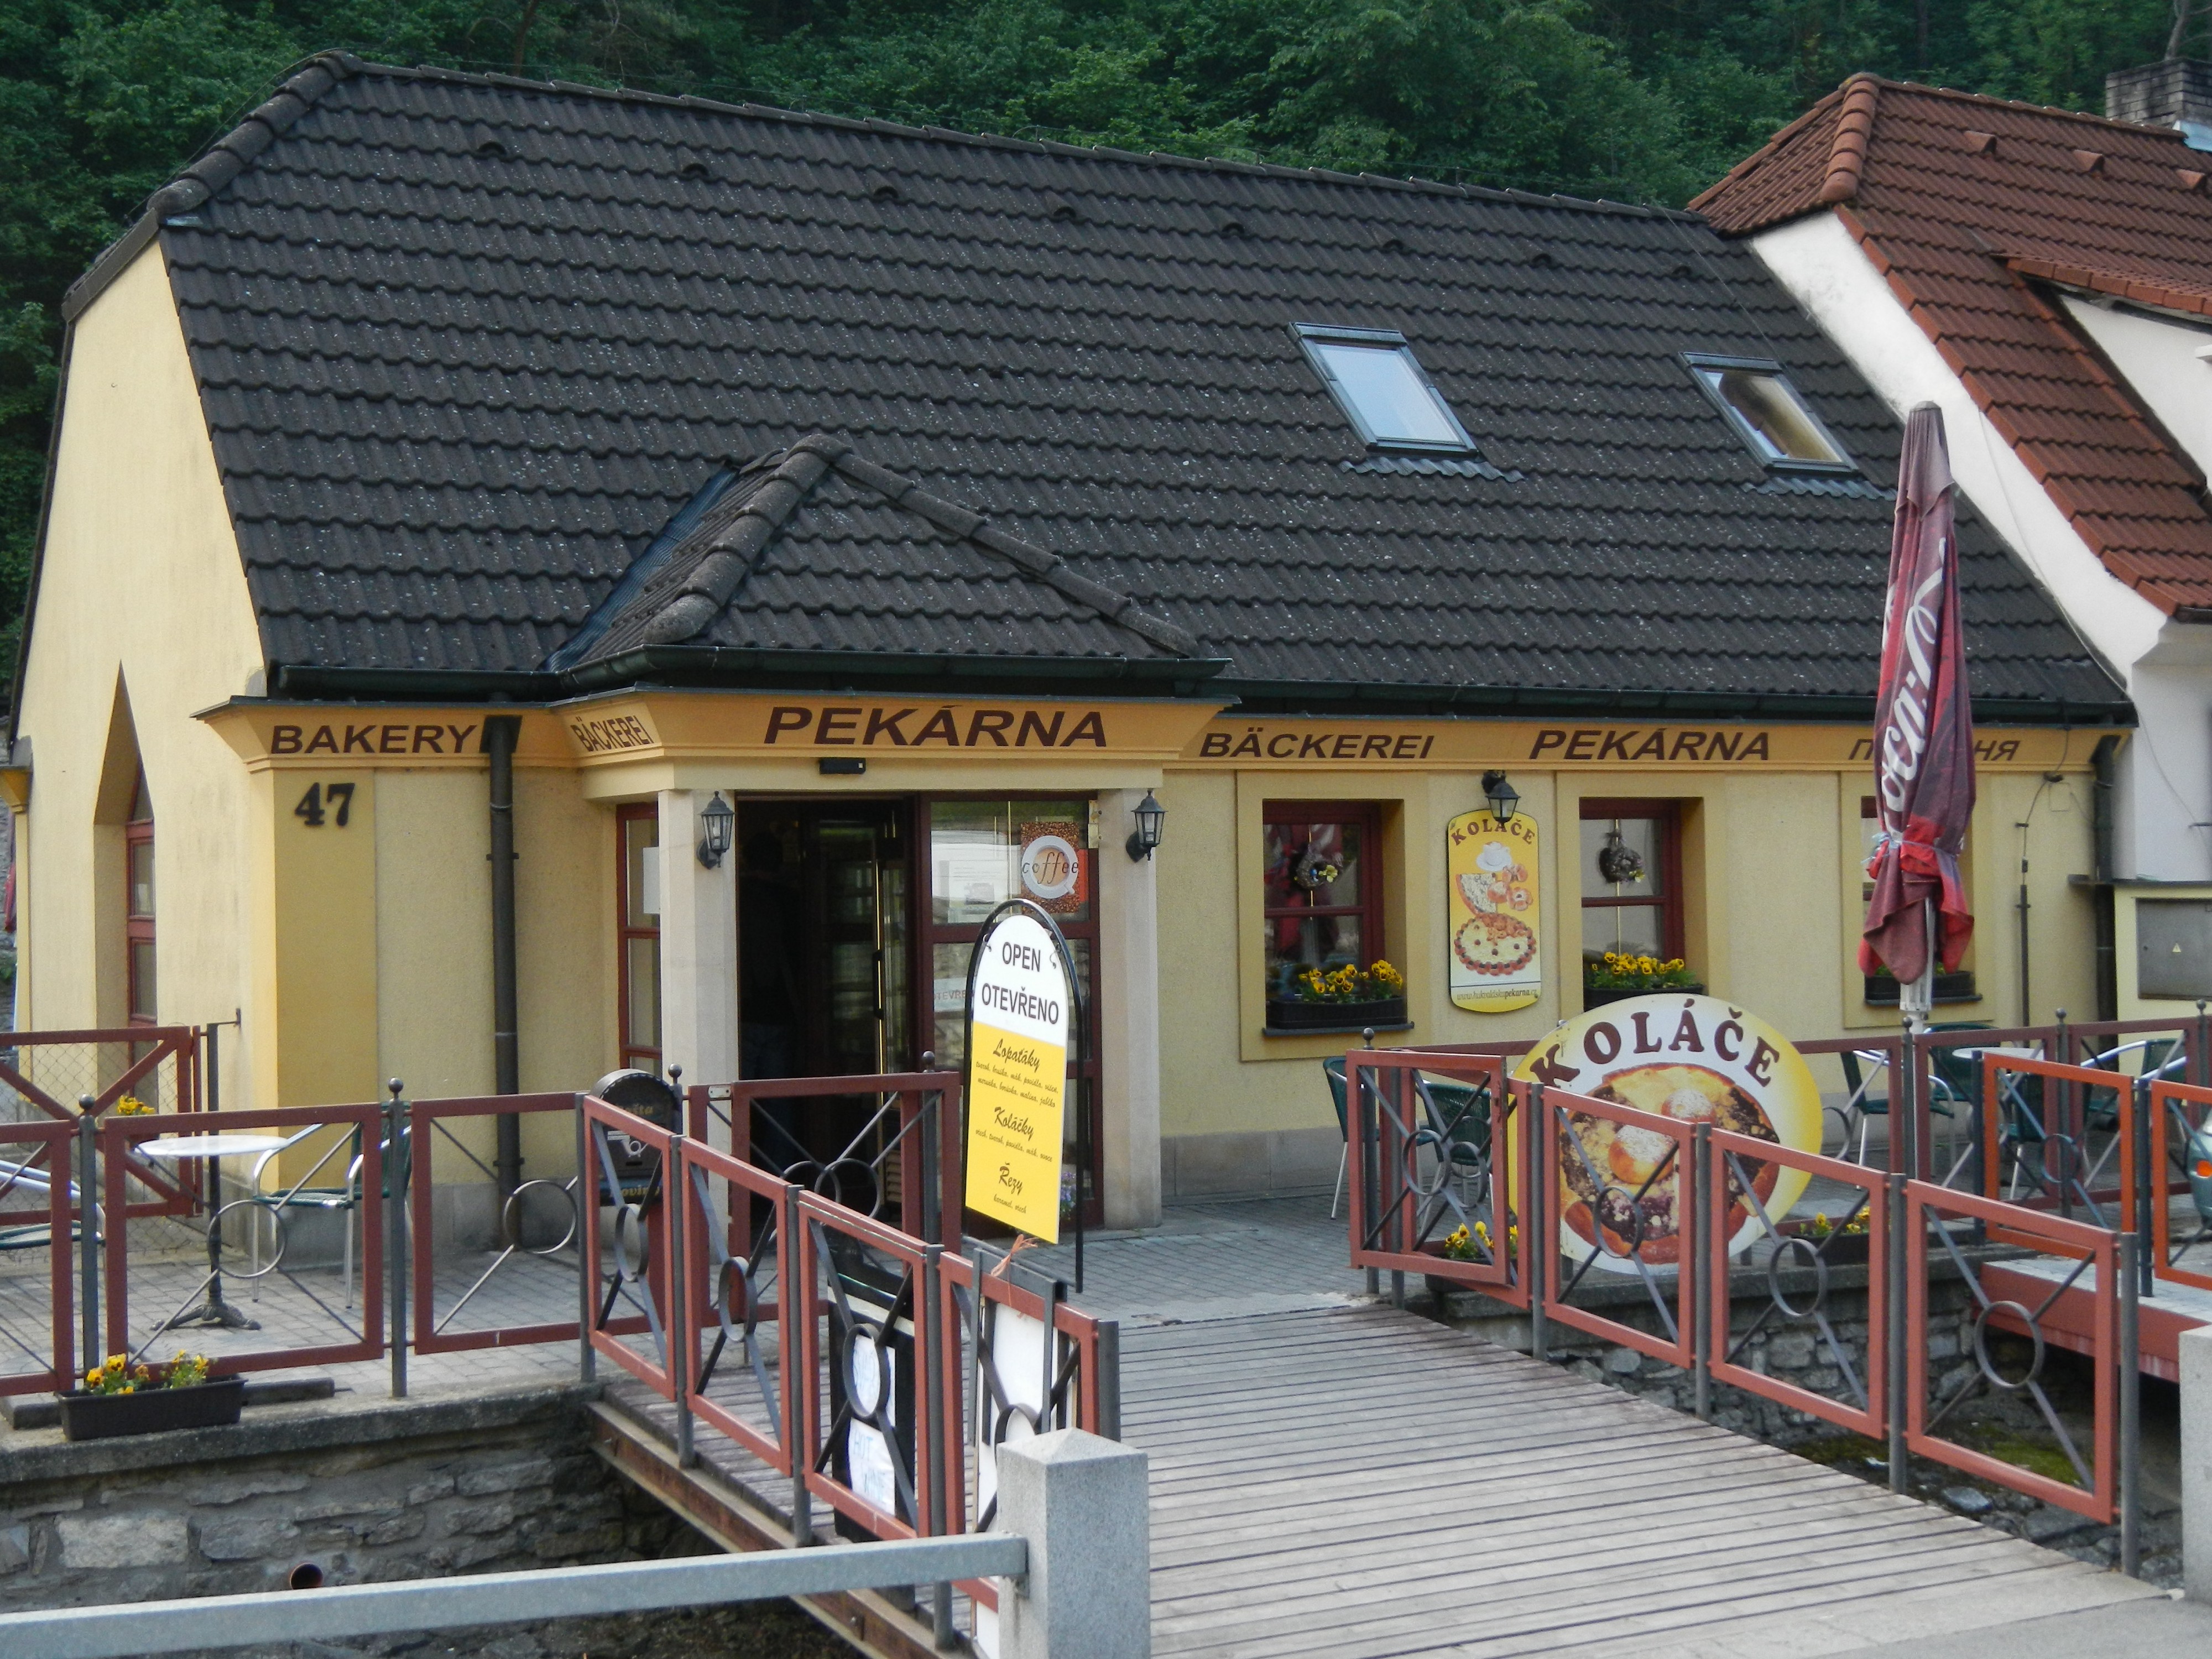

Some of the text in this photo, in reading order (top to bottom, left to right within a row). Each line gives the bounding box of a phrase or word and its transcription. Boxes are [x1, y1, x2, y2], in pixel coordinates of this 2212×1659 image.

[271, 724, 477, 754] BAKERY
[570, 715, 654, 752] BÄCKEREI
[764, 705, 1107, 748] PEKÁRNA
[1199, 727, 1434, 759] BÄCKEREI
[1529, 728, 1769, 761] PEKÁRNA
[294, 782, 356, 826] 47
[1022, 852, 1079, 884] coffee
[1002, 942, 1041, 972] OPEN
[982, 983, 1059, 1024] OTEVŘENO
[993, 1039, 1040, 1073] Lopaťáky
[1530, 993, 1780, 1089] KOLÁČE
[994, 1107, 1034, 1141] Koláčky
[999, 1162, 1022, 1195] Řezy
